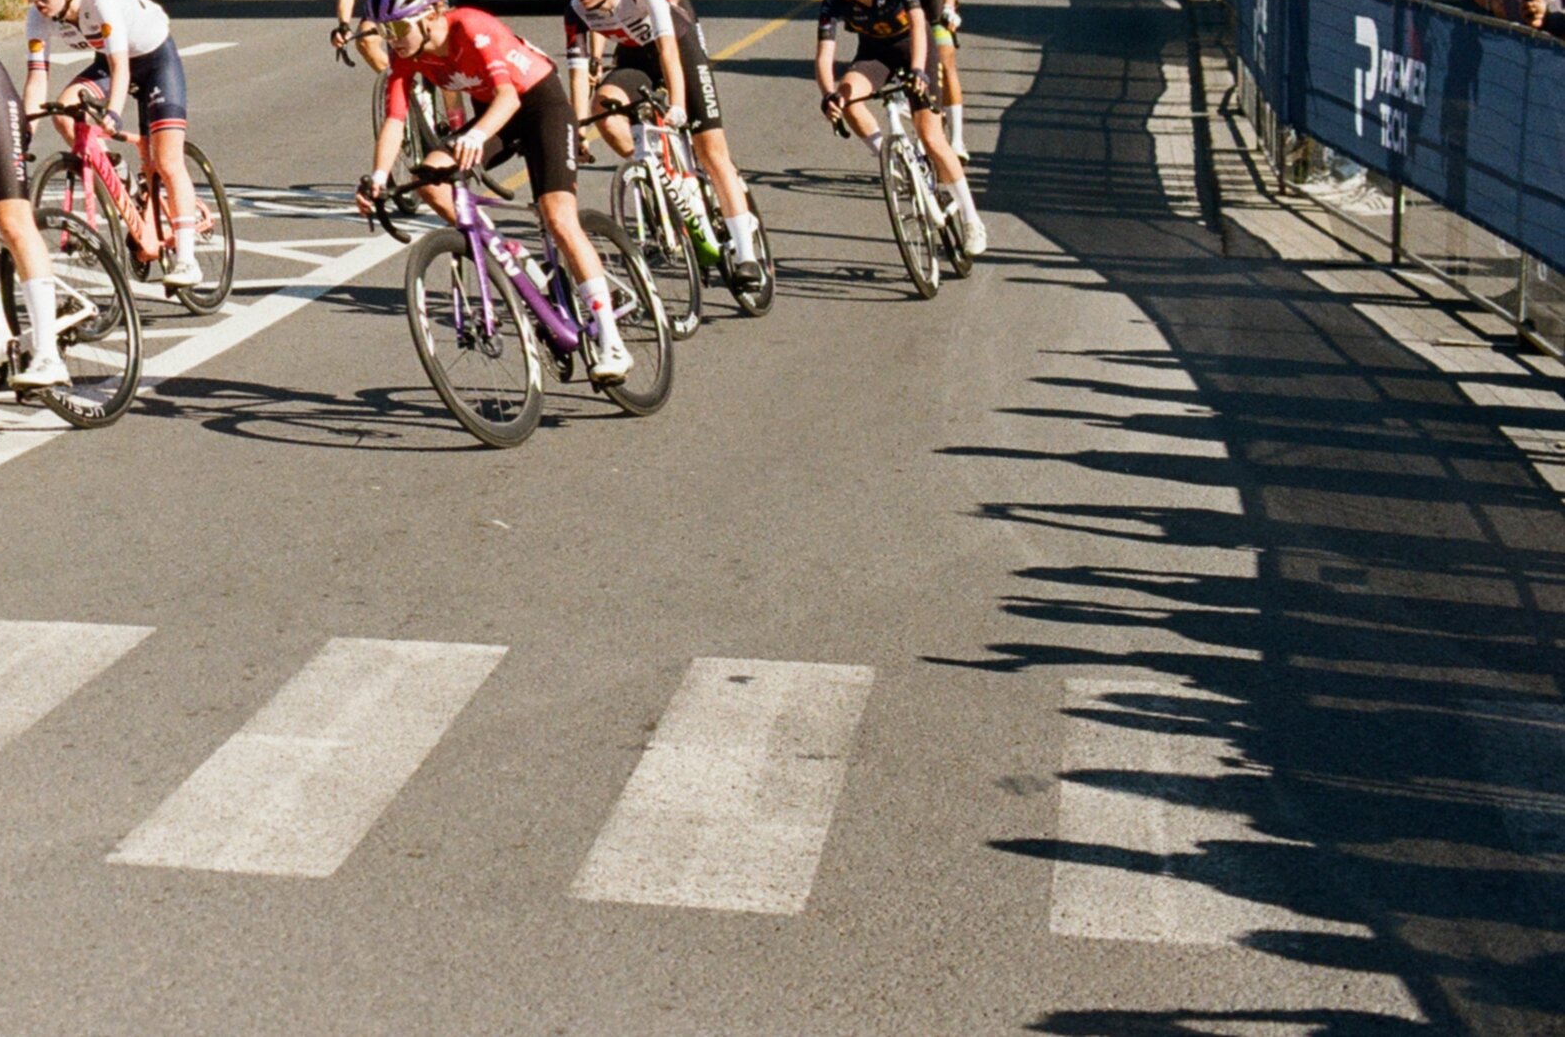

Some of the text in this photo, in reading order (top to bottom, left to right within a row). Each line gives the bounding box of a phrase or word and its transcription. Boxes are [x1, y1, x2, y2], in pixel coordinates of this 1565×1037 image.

[697, 64, 719, 119] EVIDEN
[1380, 49, 1428, 107] PREMIER
[1379, 103, 1408, 156] TECH
